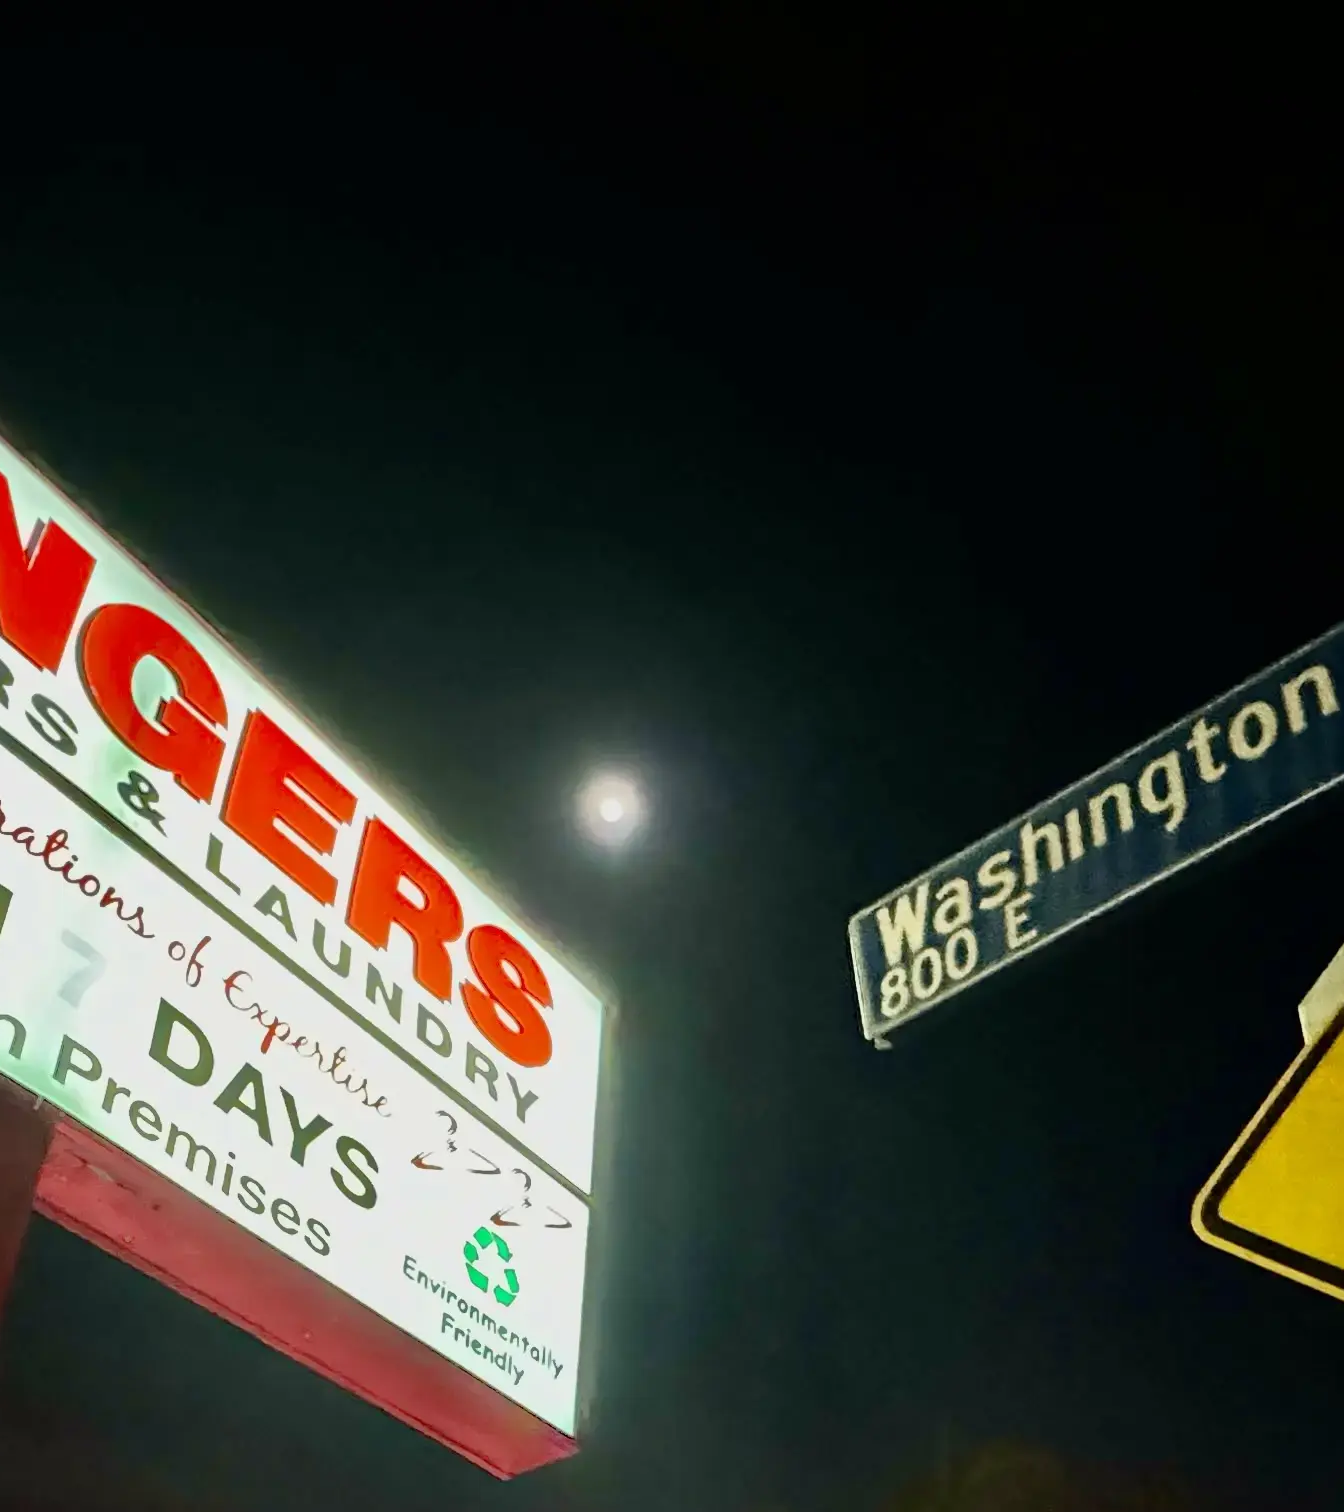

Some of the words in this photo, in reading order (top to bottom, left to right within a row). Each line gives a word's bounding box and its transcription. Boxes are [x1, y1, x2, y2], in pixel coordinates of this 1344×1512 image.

[876, 663, 1341, 967] Washington
[118, 770, 166, 837] &
[207, 839, 540, 1124] LAUNDRY
[167, 936, 212, 988] of
[223, 971, 393, 1118] Expertise
[879, 931, 978, 1018] 800
[1003, 892, 1038, 951] E
[52, 1034, 332, 1257] Premises
[54, 929, 107, 1008] 7
[148, 997, 379, 1210] DAYS
[402, 1255, 564, 1381] Environmentally
[440, 1312, 525, 1386] Friendly
